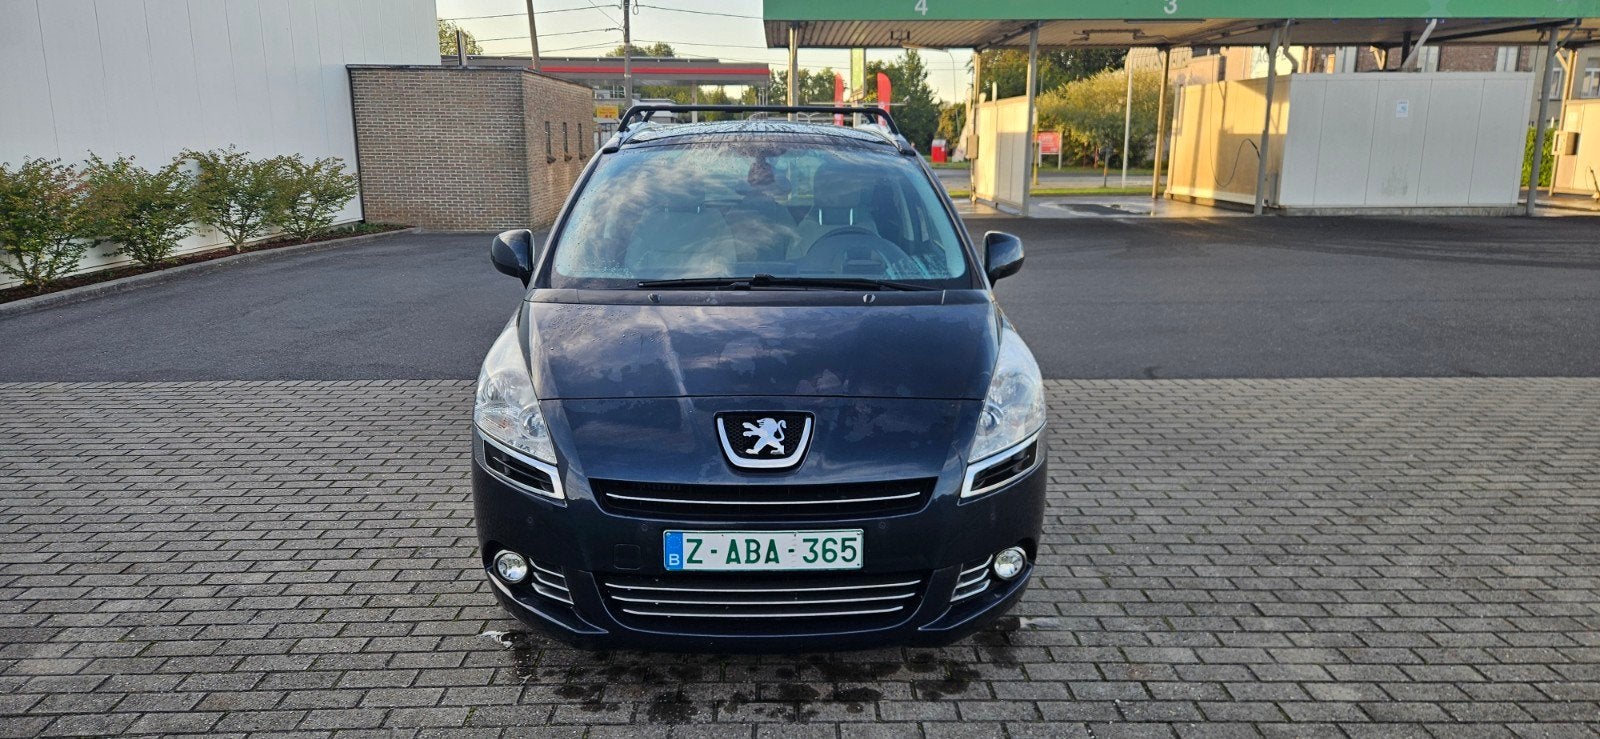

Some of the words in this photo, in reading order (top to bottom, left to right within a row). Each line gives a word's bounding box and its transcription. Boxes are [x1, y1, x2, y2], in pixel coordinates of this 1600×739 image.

[914, 0, 929, 16] 4
[1163, 0, 1178, 15] 3
[668, 553, 681, 566] B
